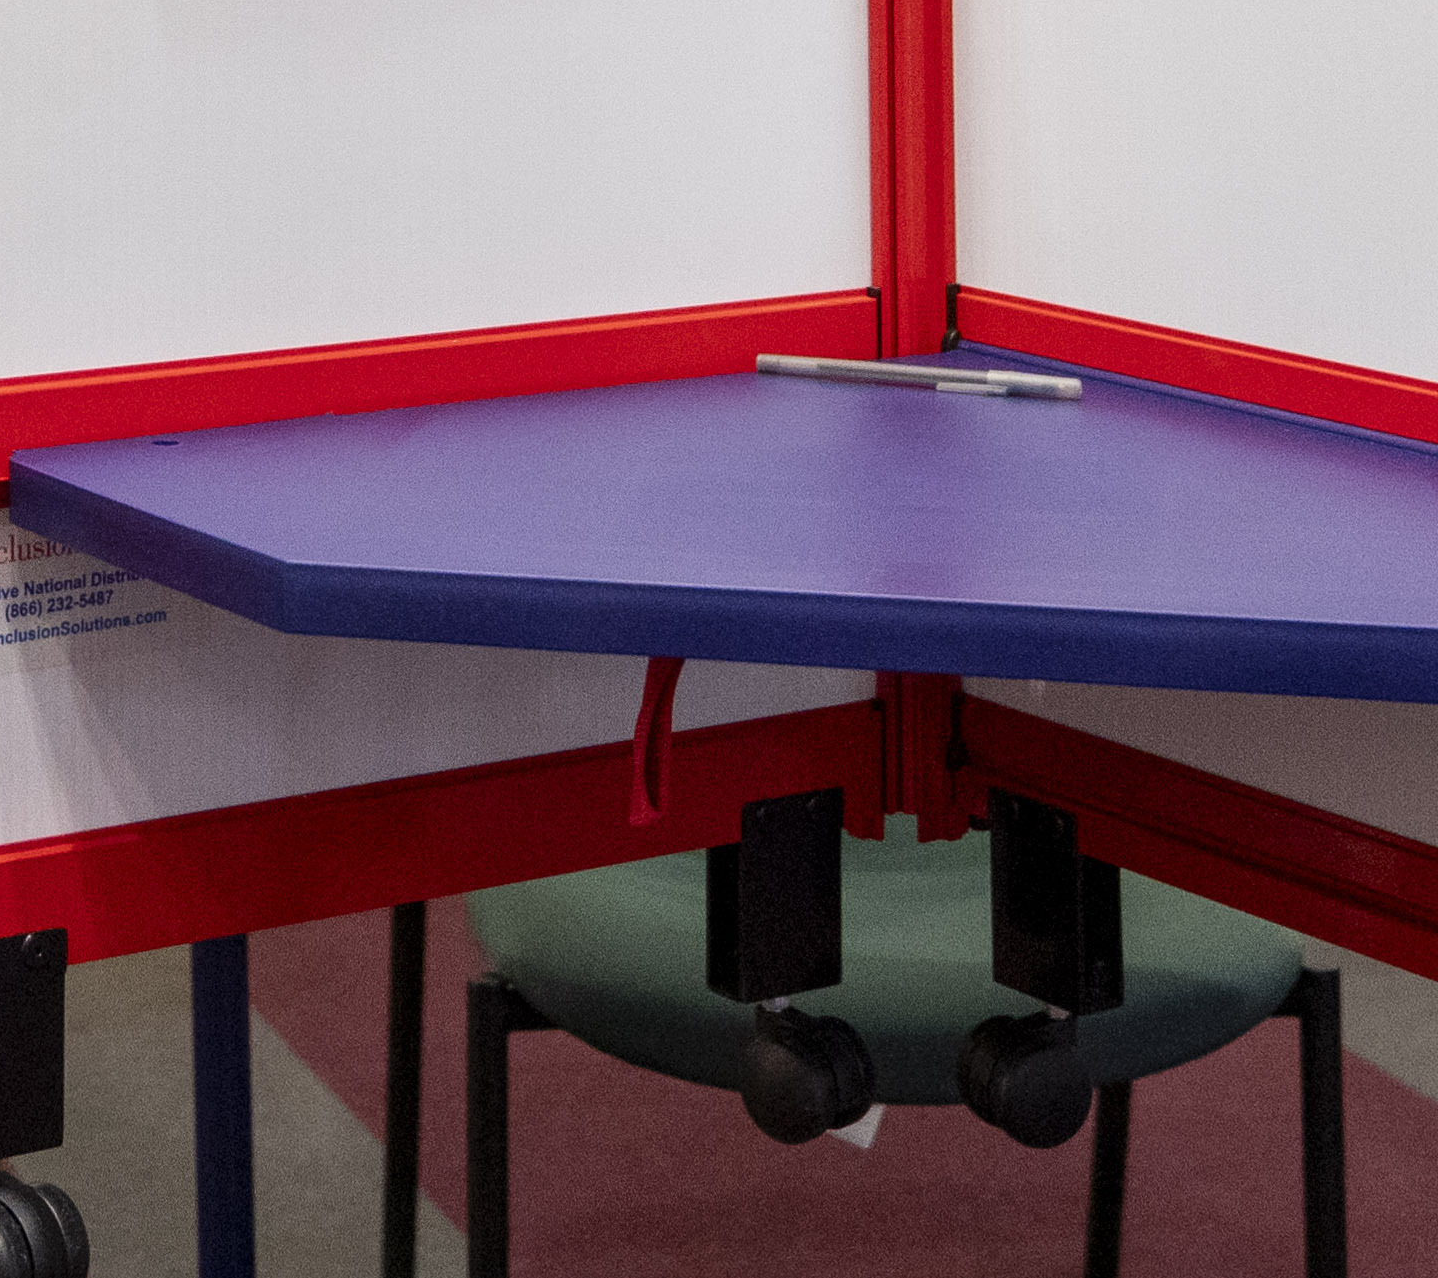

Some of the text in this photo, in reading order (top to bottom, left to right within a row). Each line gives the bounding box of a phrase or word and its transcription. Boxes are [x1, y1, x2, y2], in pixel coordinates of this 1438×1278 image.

[22, 574, 87, 596] National
[5, 589, 114, 623] (866) 232-5487
